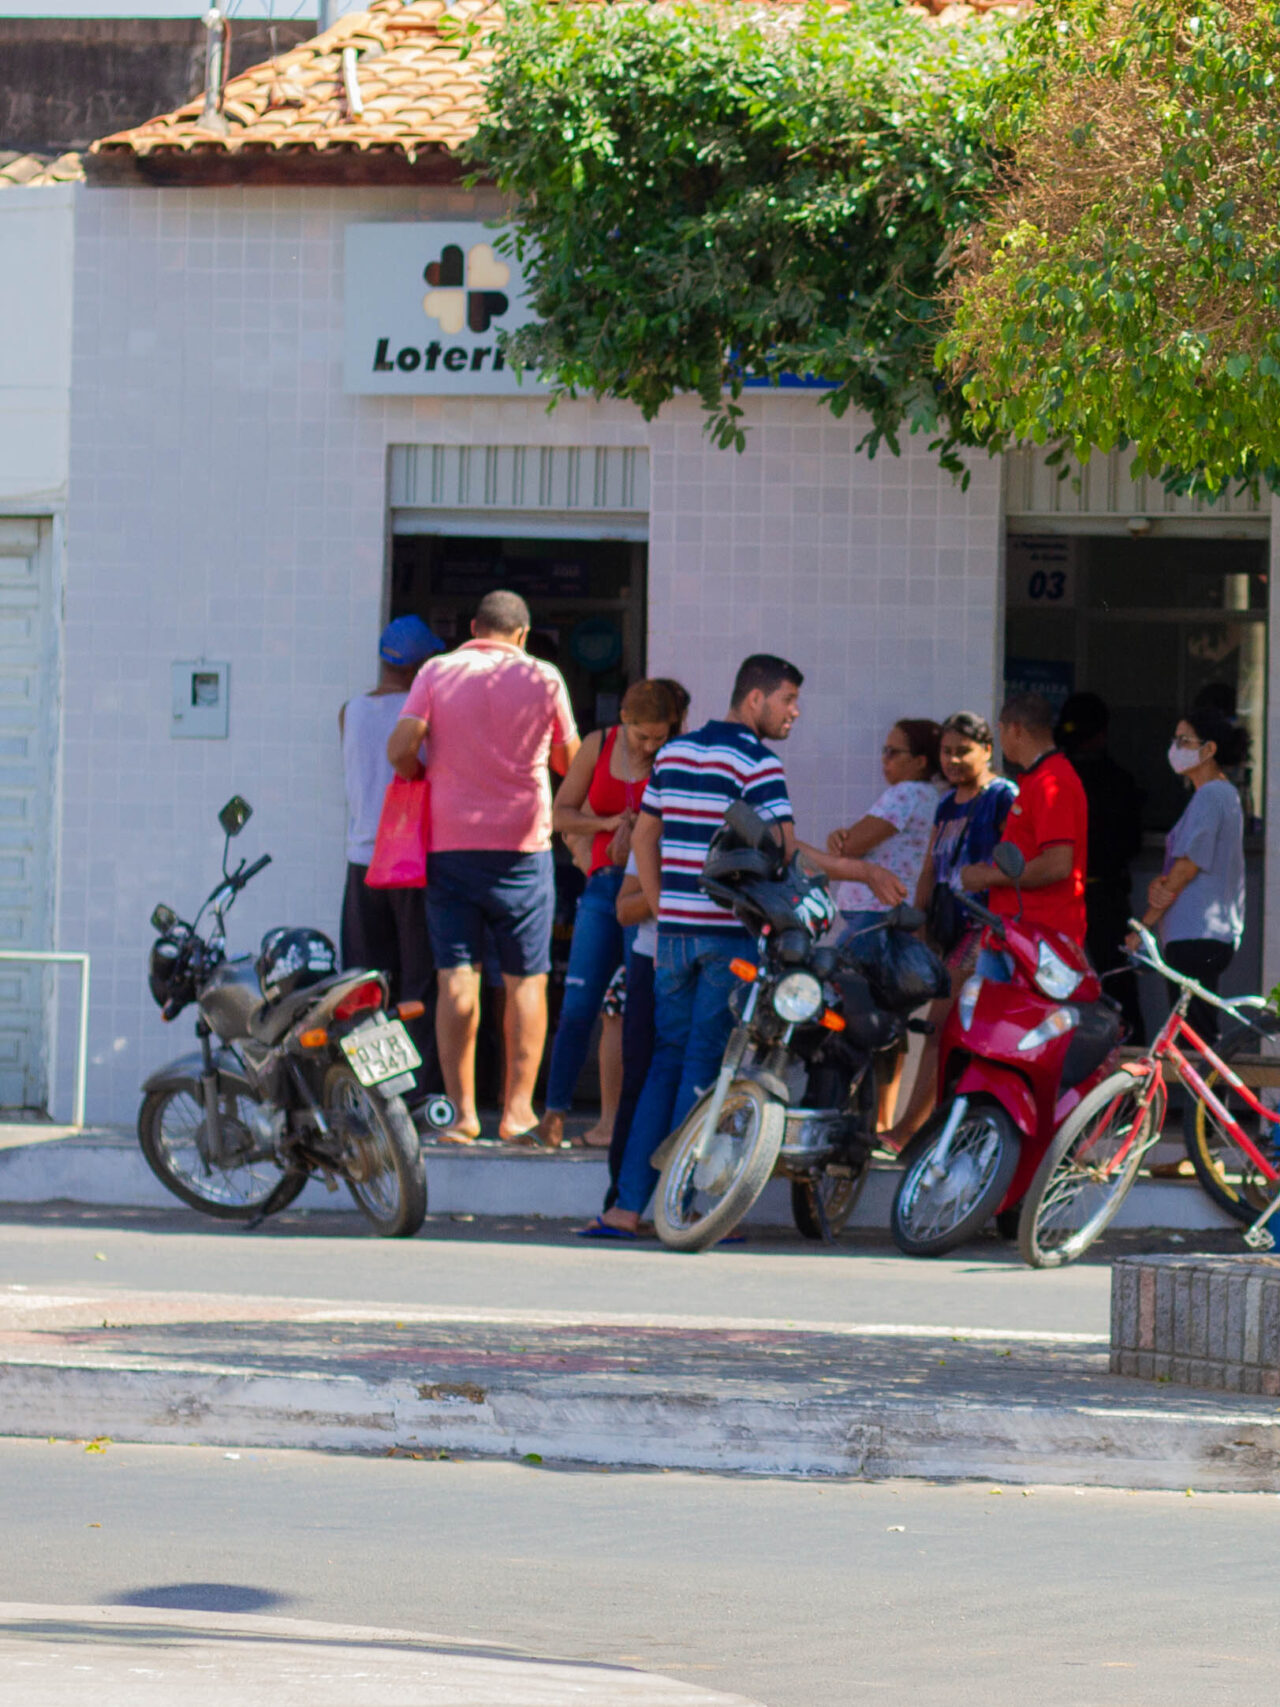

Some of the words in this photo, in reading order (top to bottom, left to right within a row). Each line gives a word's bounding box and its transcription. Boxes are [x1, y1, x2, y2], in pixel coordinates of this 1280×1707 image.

[372, 337, 536, 372] Loteri
[1028, 570, 1066, 600] 03
[365, 1050, 409, 1080] 1347
